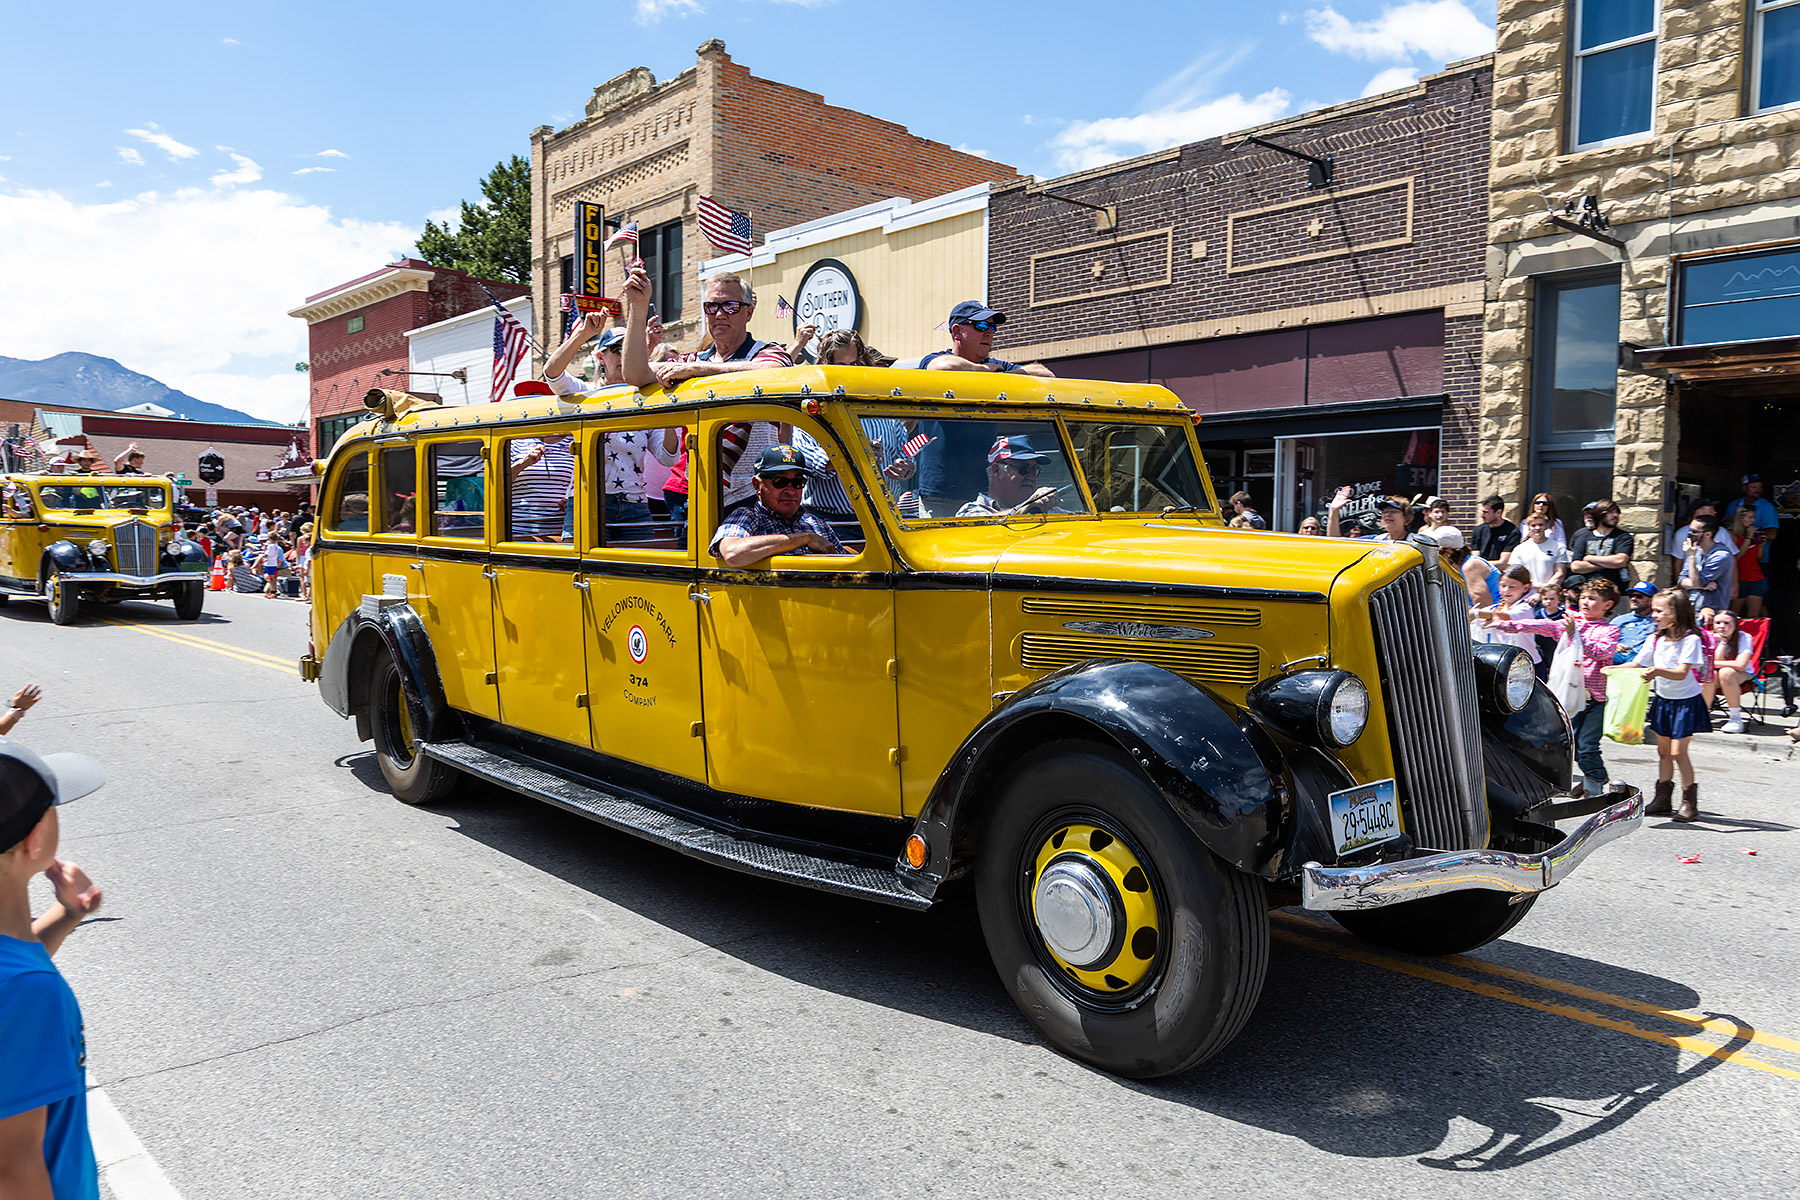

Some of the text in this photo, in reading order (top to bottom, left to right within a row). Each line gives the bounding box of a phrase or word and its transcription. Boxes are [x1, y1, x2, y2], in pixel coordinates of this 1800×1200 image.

[586, 205, 599, 294] FOLOS
[802, 289, 848, 318] SOUTHERN
[813, 312, 839, 337] DISH
[1325, 494, 1386, 519] WELER
[601, 596, 677, 648] YELLOWSTONE PARK
[629, 673, 648, 687] 374
[623, 689, 657, 707] COMPANY
[1347, 788, 1379, 808] MONTANA
